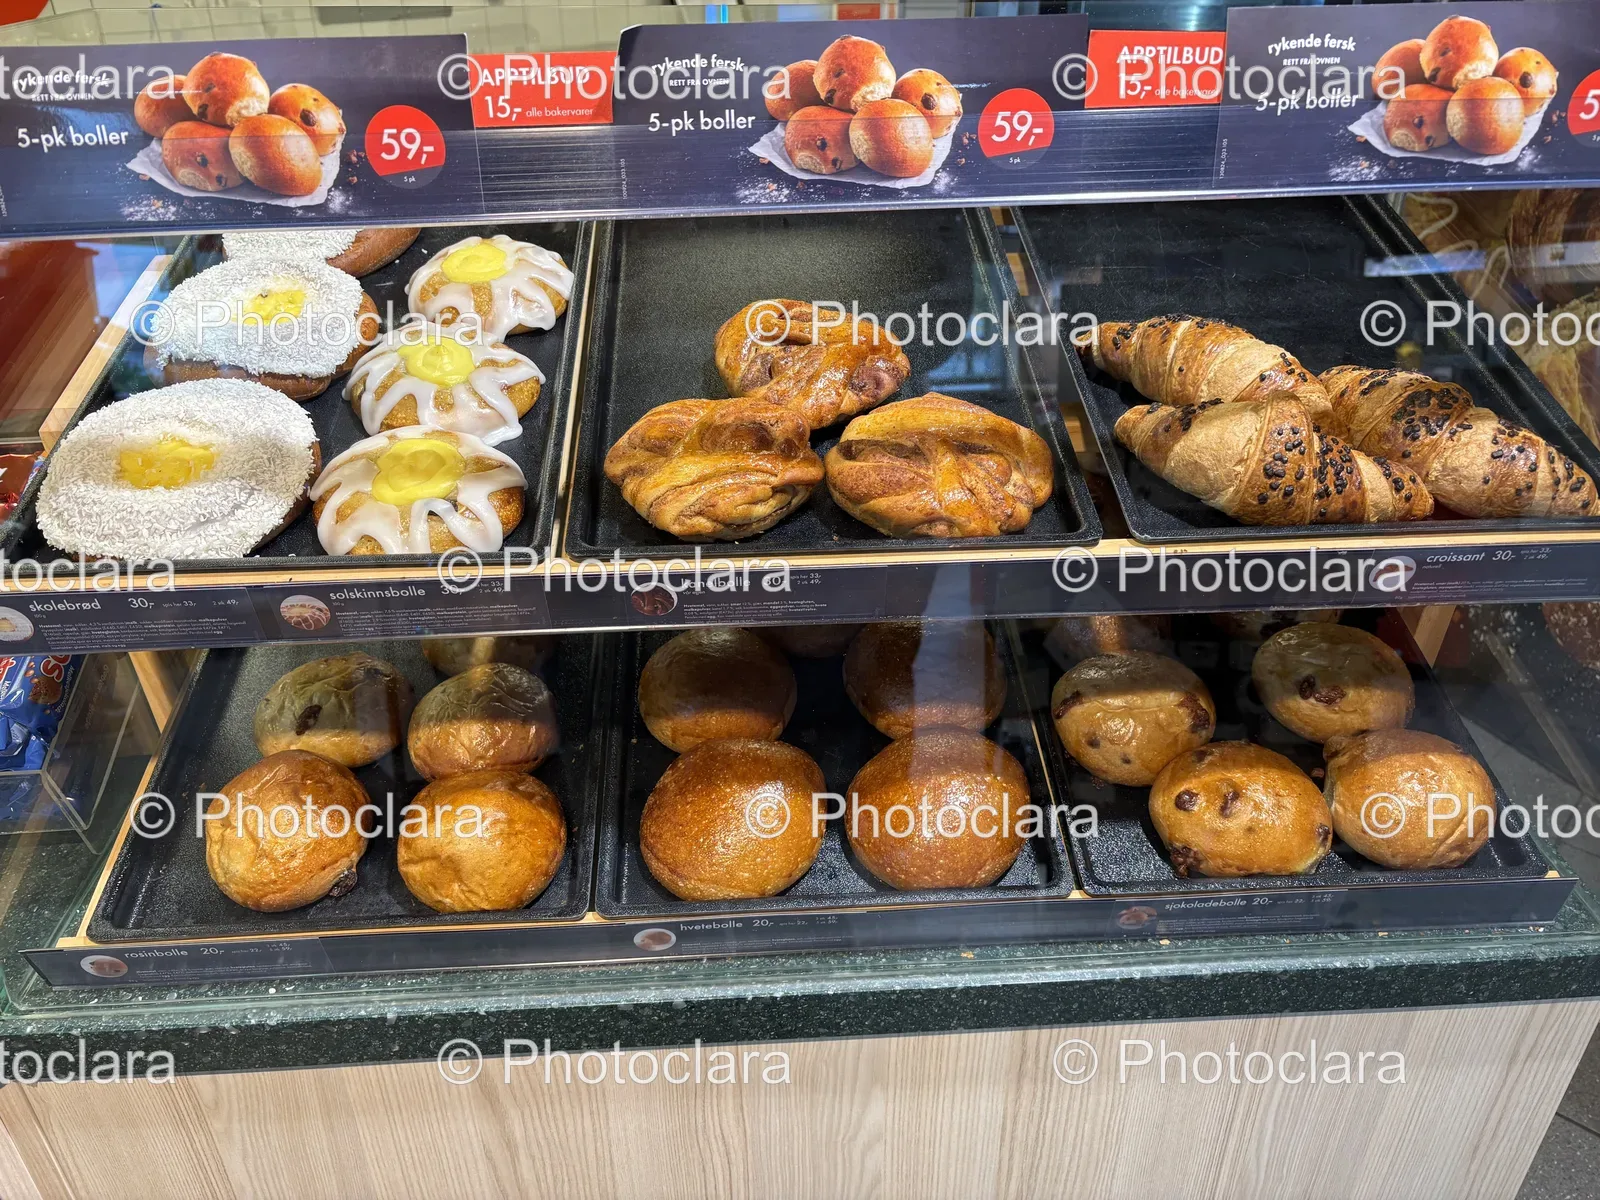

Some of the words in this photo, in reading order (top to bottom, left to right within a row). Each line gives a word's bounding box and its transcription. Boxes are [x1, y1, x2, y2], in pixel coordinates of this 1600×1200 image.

[1268, 34, 1323, 56] rykende
[1324, 33, 1356, 52] fersk
[650, 54, 708, 76] rykende
[710, 54, 745, 72] fersk
[1116, 45, 1224, 65] APPTILBUD
[1282, 58, 1299, 66] RETT
[1315, 56, 1340, 65] OVNEN
[12, 71, 72, 92] rykende
[74, 70, 110, 88] fersk
[481, 67, 591, 87] APPTILBUD
[669, 79, 686, 87] RETT
[702, 77, 730, 86] OVNEN
[485, 96, 522, 121] 15,-
[525, 107, 543, 118] alle
[544, 106, 594, 118] bakervarer
[1255, 91, 1301, 116] 5-pk
[1305, 88, 1359, 110] boller
[648, 111, 693, 137] 5-pk
[699, 109, 756, 131] boller
[990, 110, 1044, 146] 59,-
[17, 127, 66, 153] 5-pk
[71, 122, 129, 148] boller
[380, 127, 435, 165] 59,-
[1426, 552, 1485, 563] croissant
[1492, 550, 1516, 562] 30,-
[329, 586, 426, 601] solskinnsbolle
[29, 598, 102, 613] skolebrød
[127, 597, 155, 610] 30,-
[1165, 897, 1248, 911] sjokoladebolle
[1252, 897, 1273, 906] 20,-
[680, 920, 743, 932] hvetebolle
[752, 918, 774, 927] 20,-
[124, 948, 189, 960] rosinbolle
[199, 947, 225, 956] 20,-
